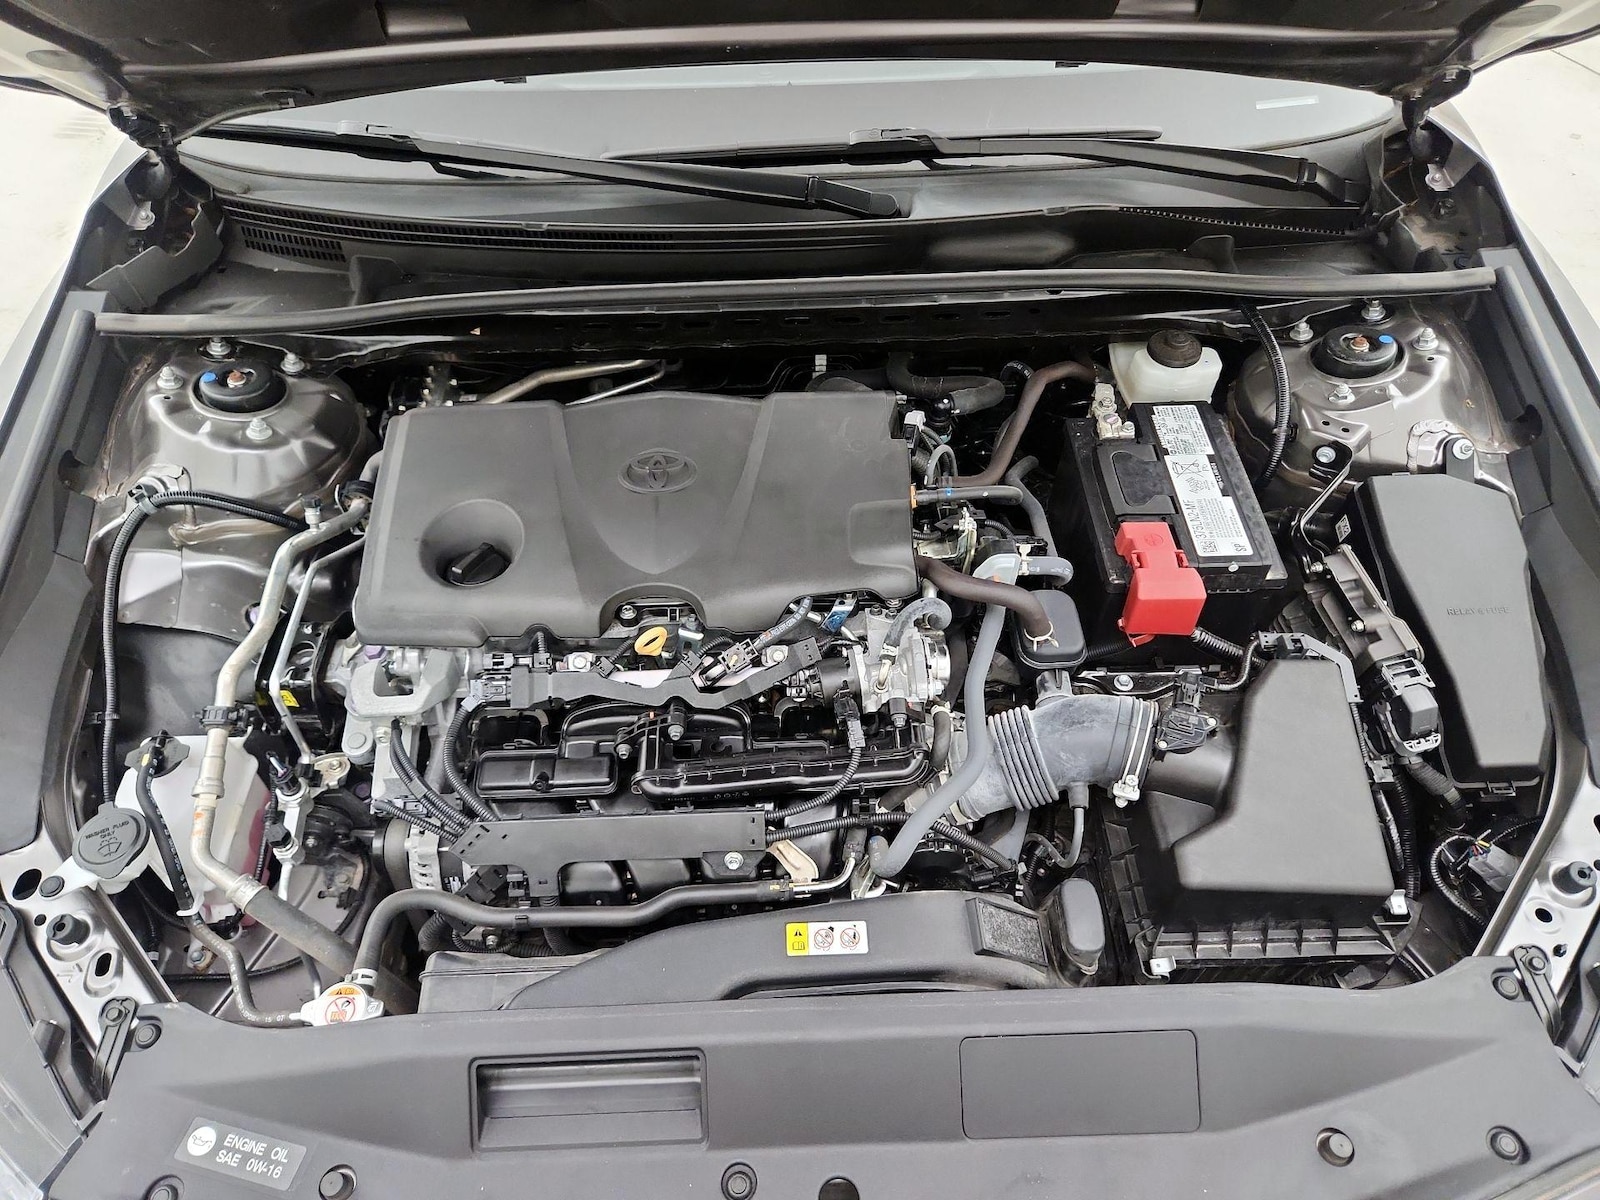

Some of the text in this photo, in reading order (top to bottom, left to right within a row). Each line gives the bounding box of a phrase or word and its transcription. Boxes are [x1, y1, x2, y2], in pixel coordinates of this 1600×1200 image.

[223, 1133, 289, 1163] ENGINE OIL
[215, 1150, 283, 1179] SAE 0W-16
